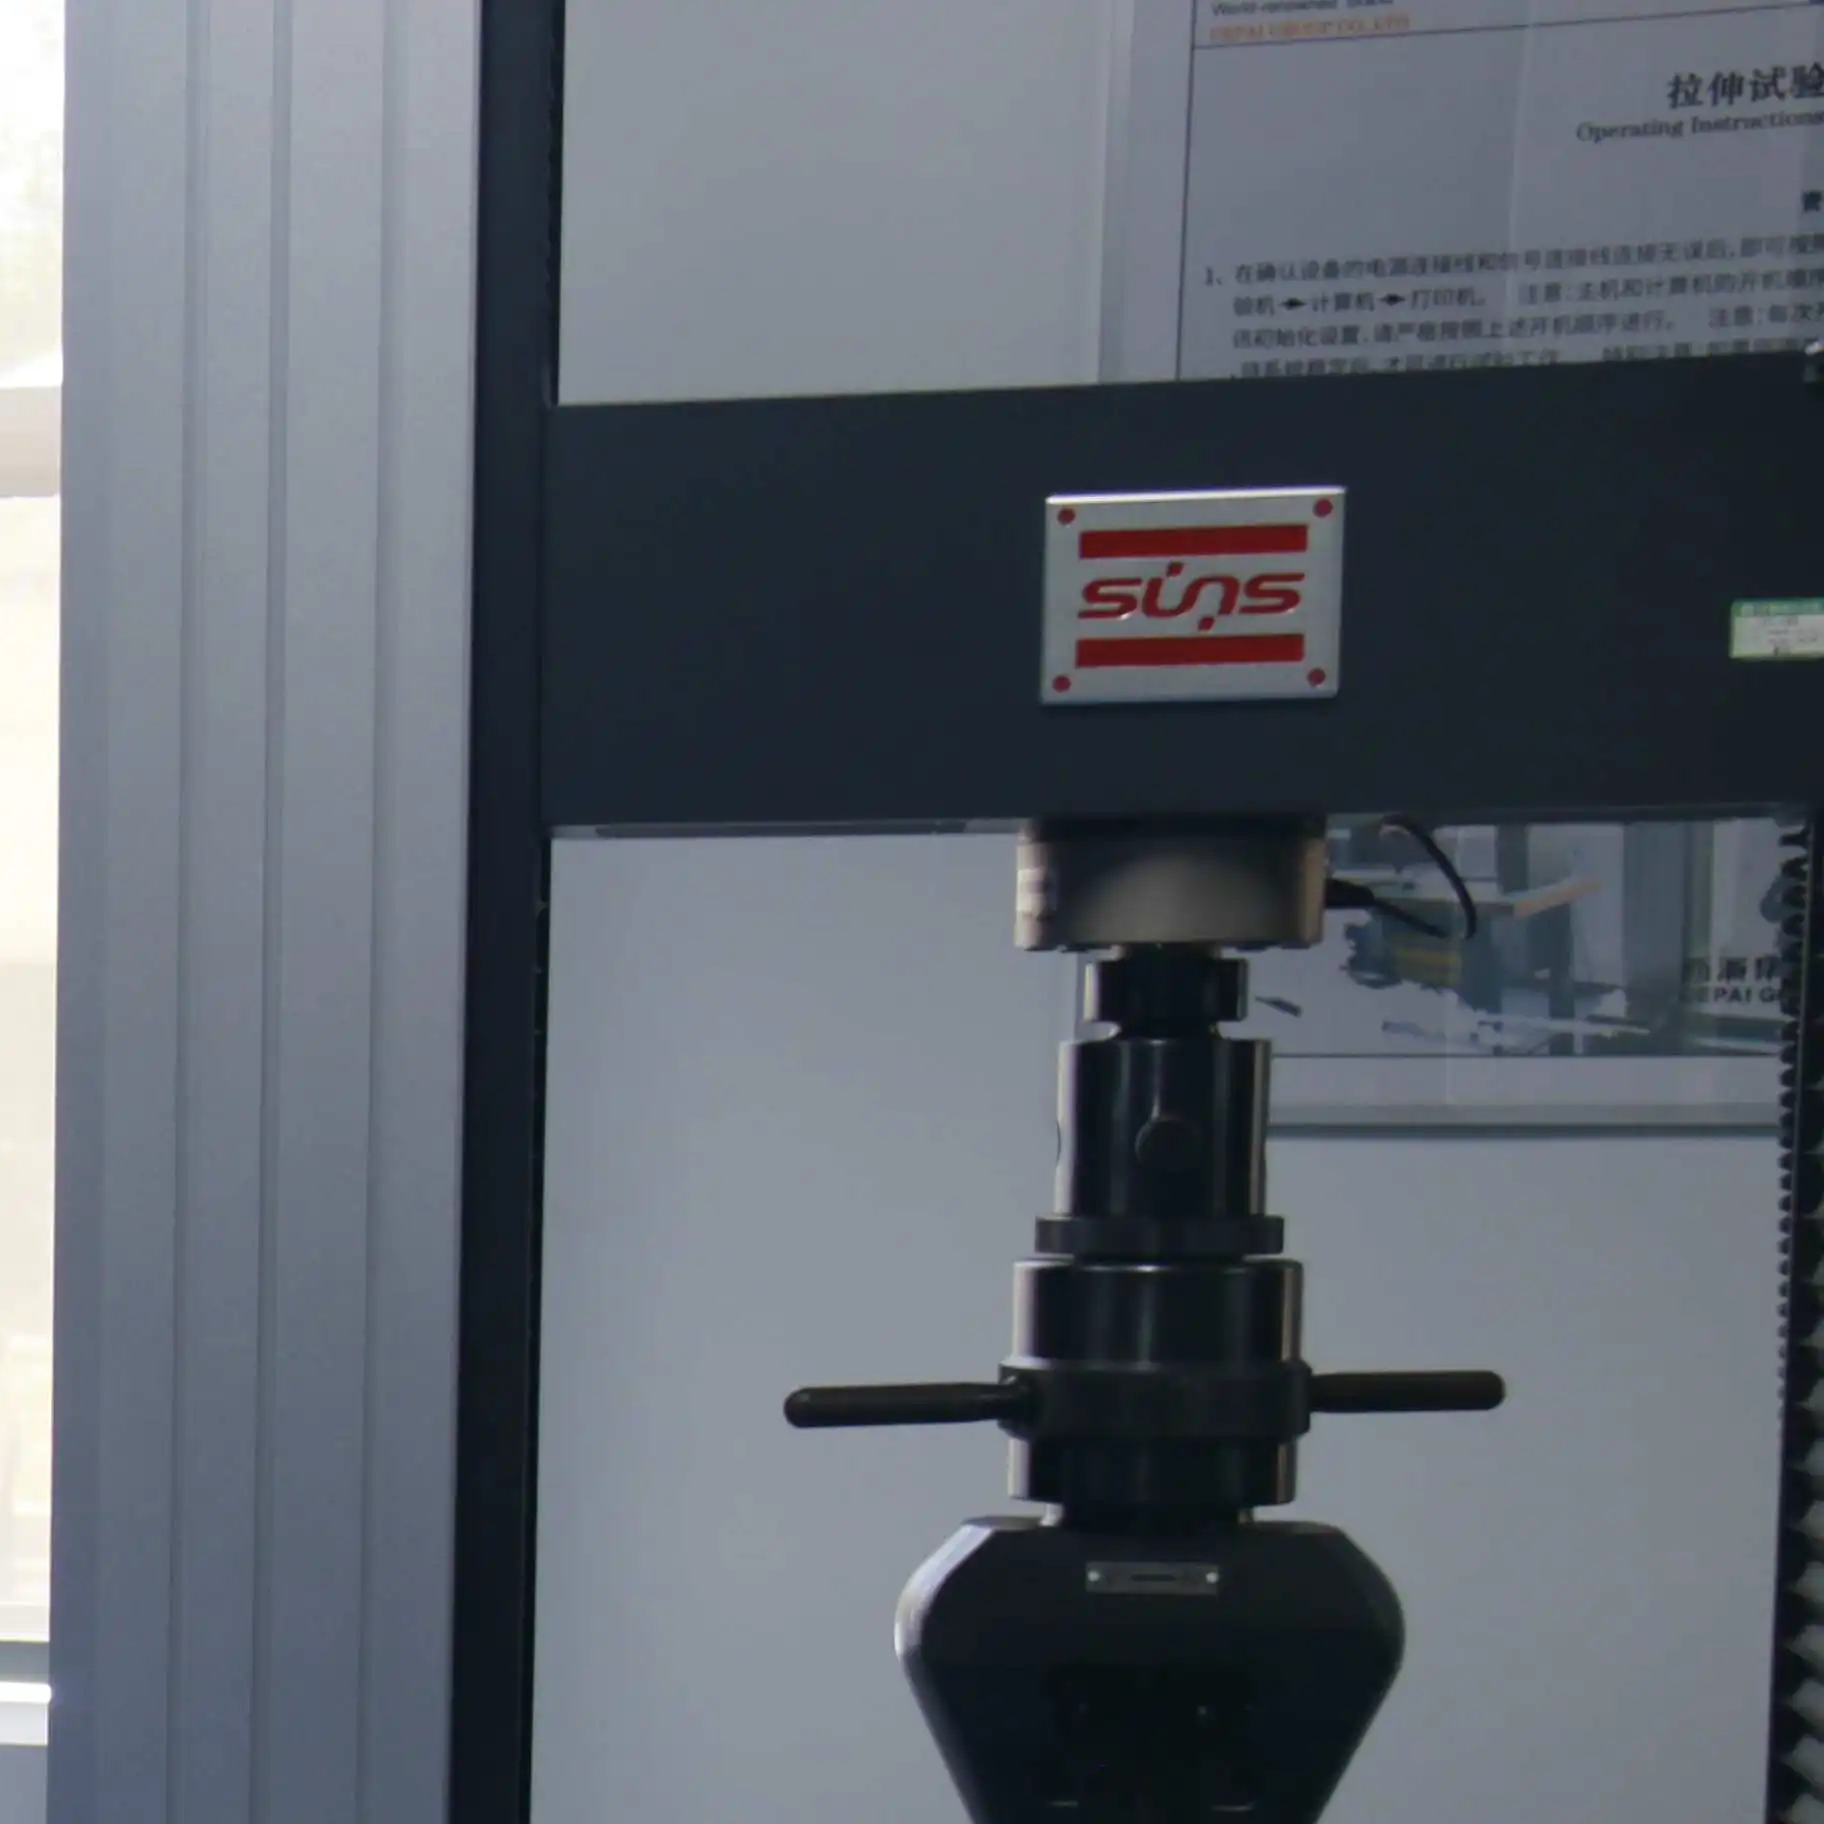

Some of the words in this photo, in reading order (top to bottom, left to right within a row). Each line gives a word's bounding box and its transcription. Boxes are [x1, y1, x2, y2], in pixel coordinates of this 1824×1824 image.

[1667, 61, 1824, 109] 拉伸试验
[1576, 117, 1685, 144] Operating
